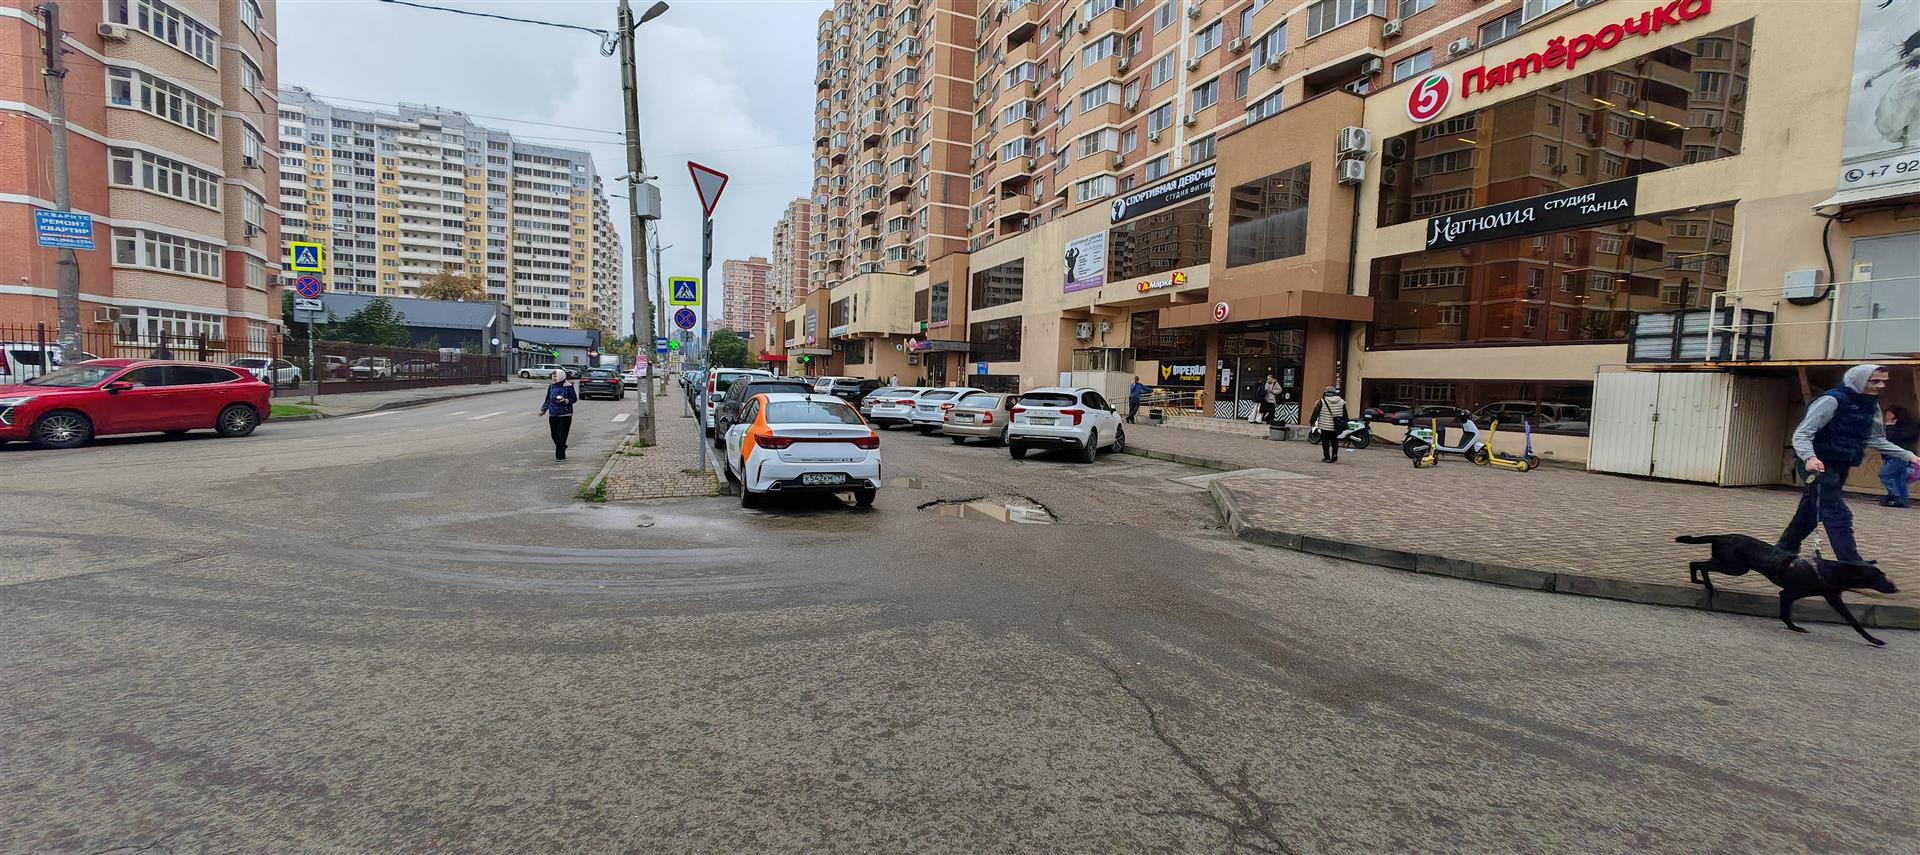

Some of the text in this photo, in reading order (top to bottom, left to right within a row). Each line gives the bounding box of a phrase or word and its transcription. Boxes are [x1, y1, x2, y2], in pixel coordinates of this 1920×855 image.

[1461, 0, 1713, 99] Пятёрочка
[1866, 160, 1920, 177] +7 92
[1126, 180, 1177, 206] СПОРТИВНАЯ
[1165, 189, 1189, 201] СТУДИЯ
[1544, 192, 1596, 210] СТУДИЯ
[1580, 197, 1629, 215] ТАНЦА
[41, 219, 86, 227] РЕМОНТ
[1149, 279, 1172, 289] Марке
